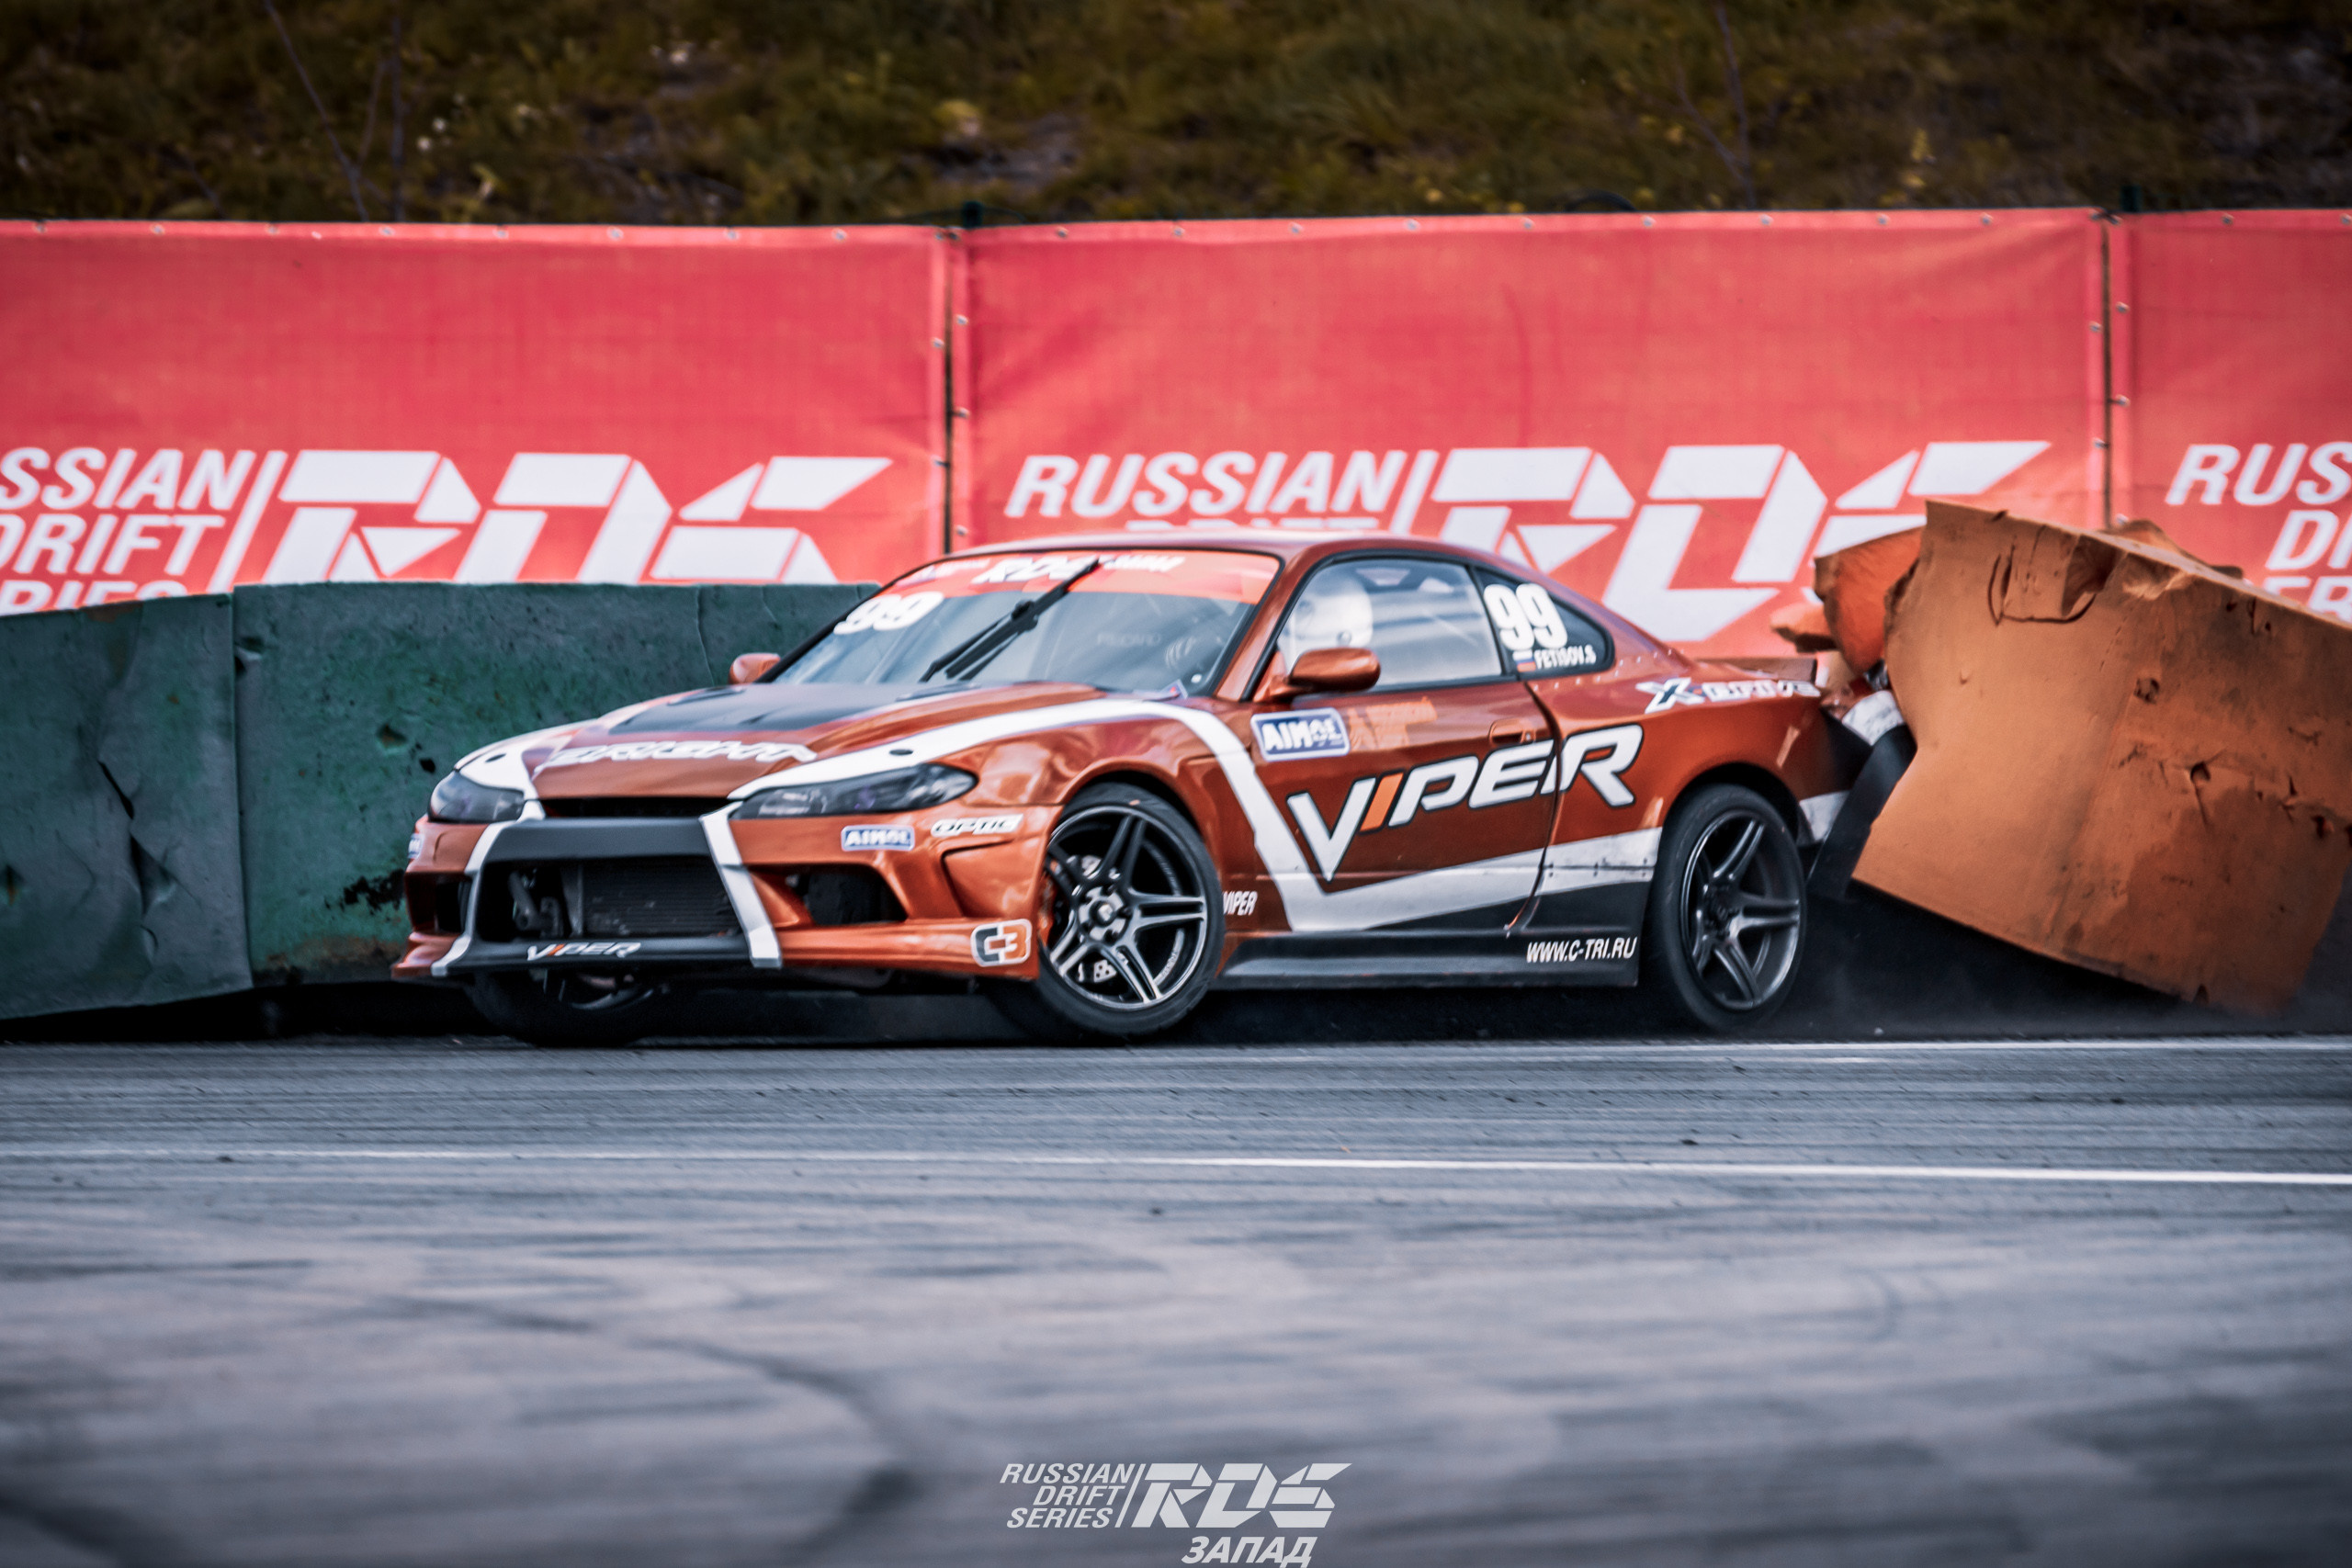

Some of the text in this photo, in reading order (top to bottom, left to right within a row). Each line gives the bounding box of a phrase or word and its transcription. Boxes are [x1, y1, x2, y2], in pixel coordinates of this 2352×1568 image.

[1004, 450, 1404, 518] RUSSIAN
[0, 513, 226, 576] RIFT
[832, 591, 944, 636] 99
[1483, 582, 1568, 651] 99
[1287, 724, 1644, 882] VIPER
[1222, 890, 1259, 916] VIPER
[526, 942, 641, 961] VIPER
[1526, 936, 1638, 963] WWW.C-TRI.RU
